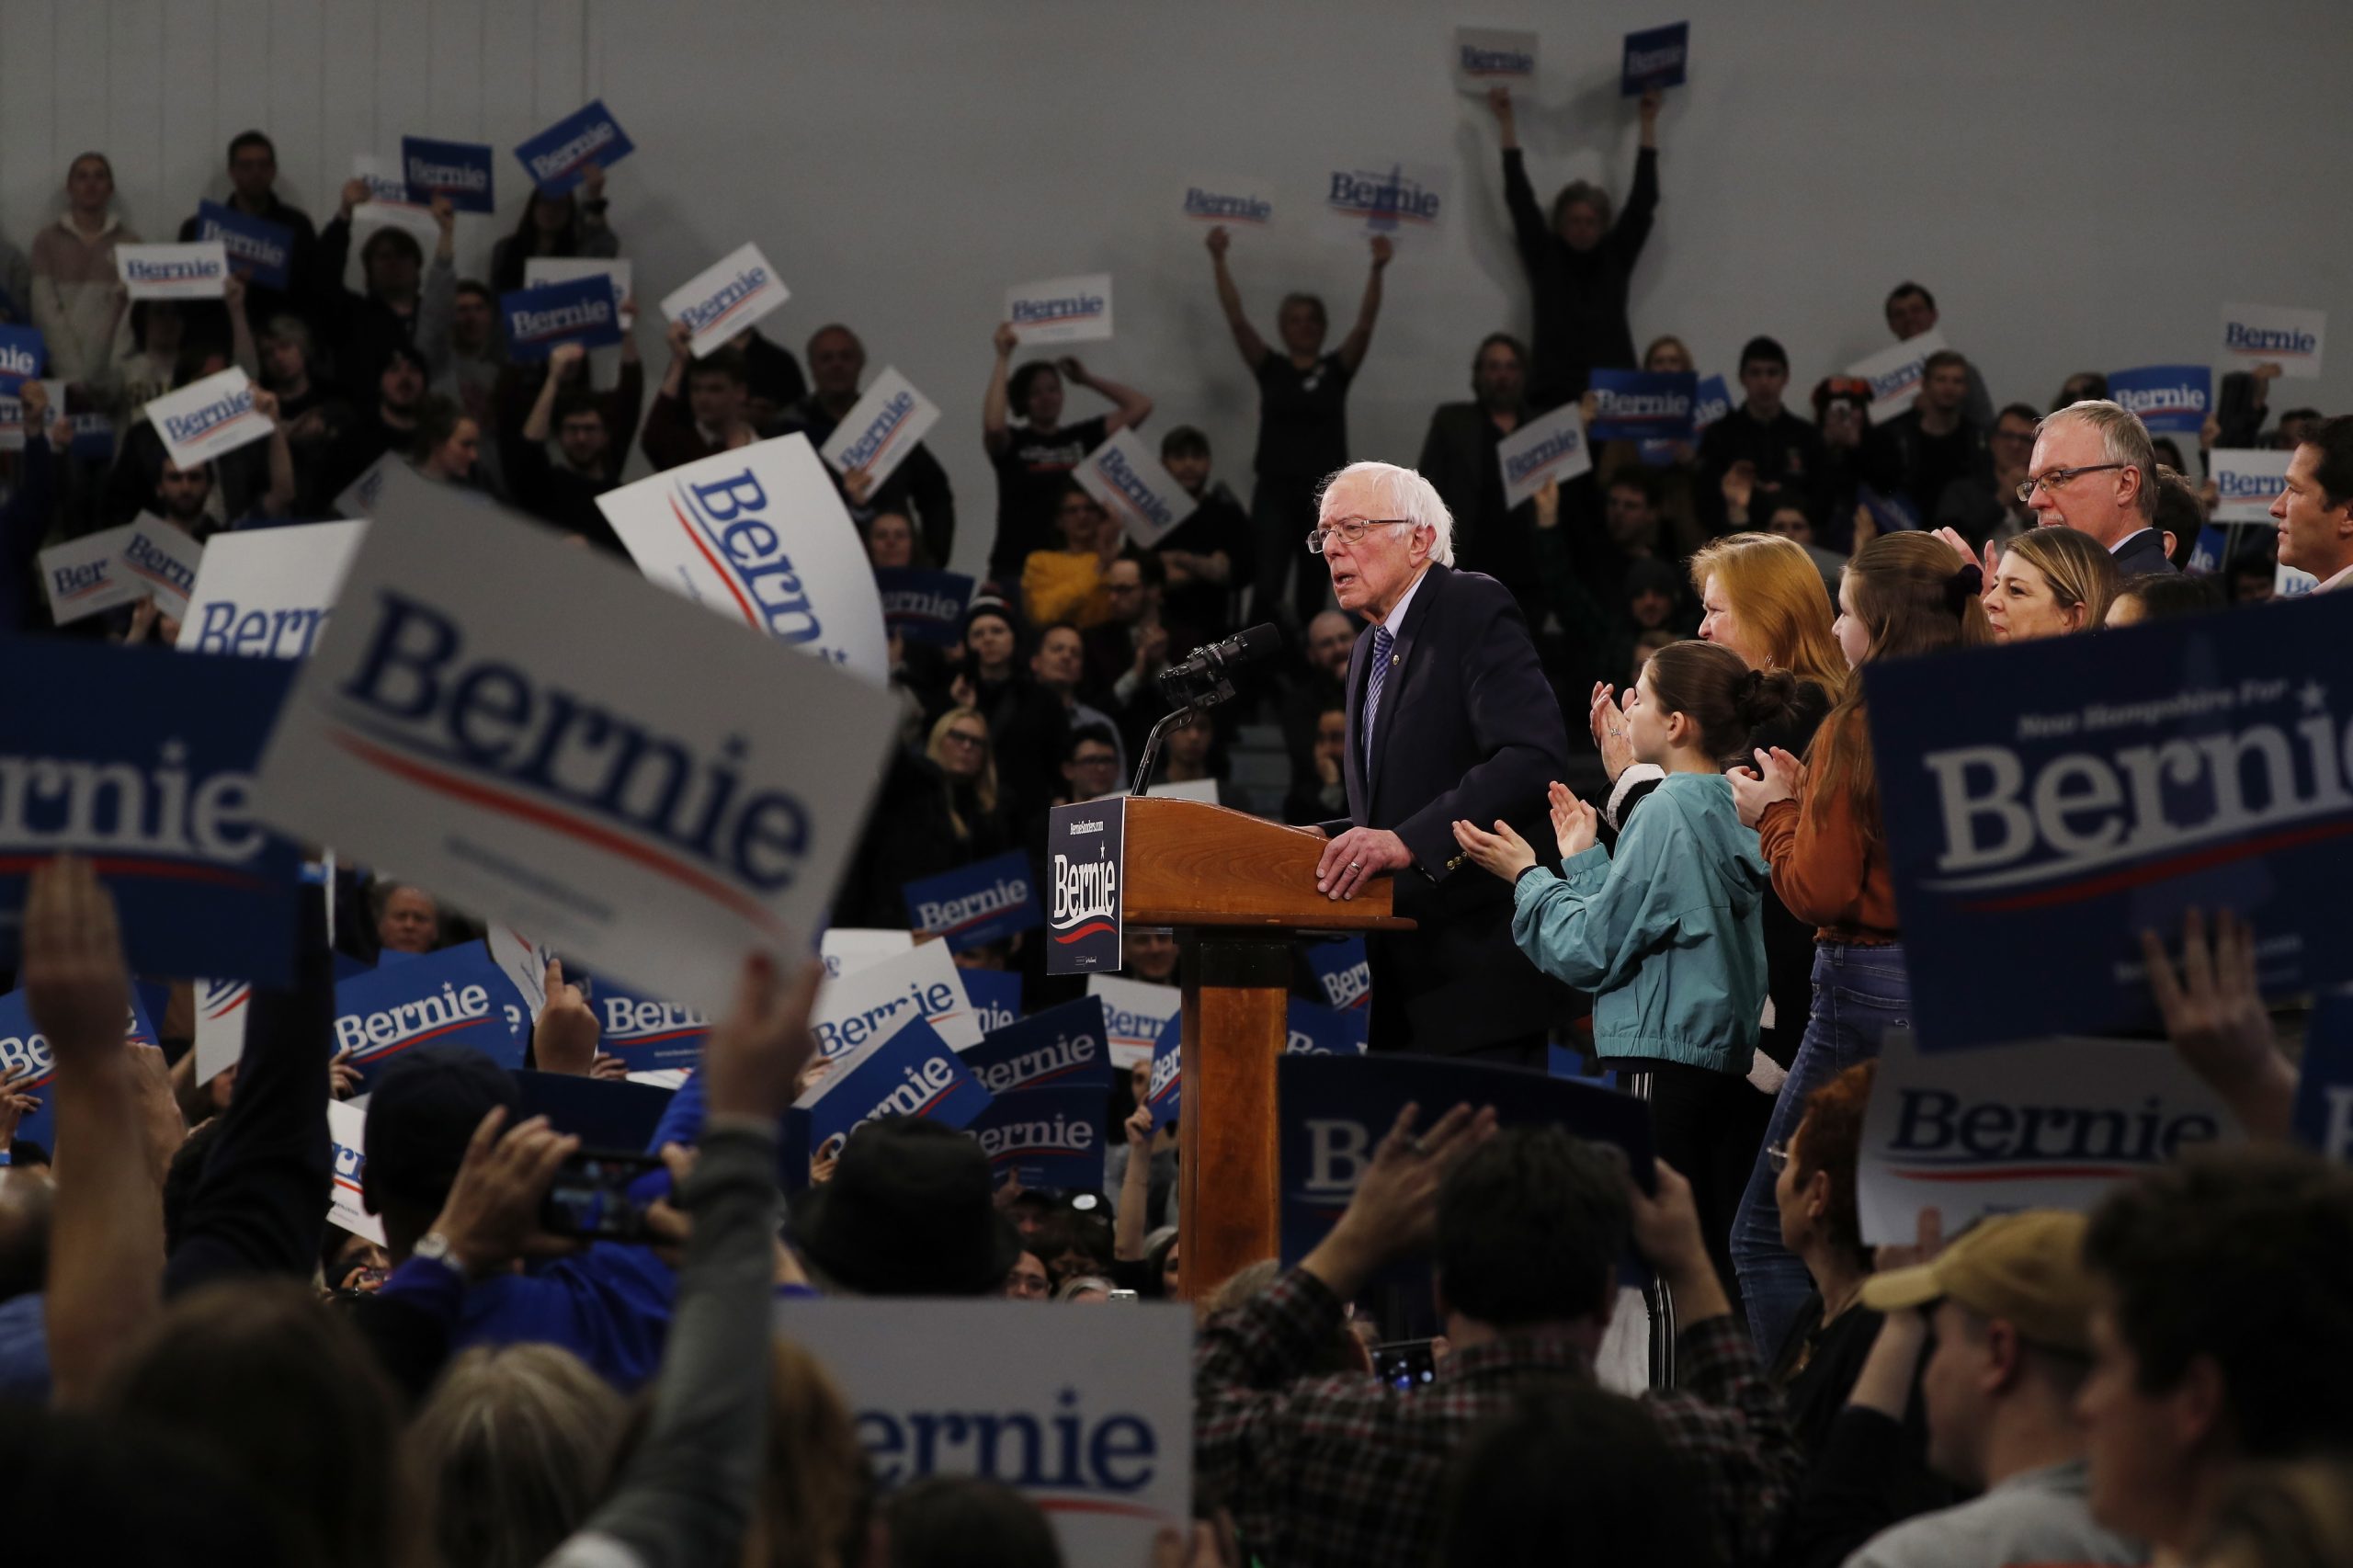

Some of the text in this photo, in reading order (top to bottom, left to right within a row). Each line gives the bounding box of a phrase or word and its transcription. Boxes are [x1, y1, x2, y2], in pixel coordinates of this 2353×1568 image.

[1330, 171, 1439, 218] Bernie
[127, 257, 221, 280] Bernie
[512, 299, 610, 336] Bernie
[680, 266, 767, 329] Bernie
[1012, 293, 1103, 322] Bernie
[2227, 323, 2315, 352] Bernie
[164, 391, 254, 443] Bernie
[1597, 387, 1690, 414] Bernie
[2116, 383, 2205, 412] Bernie
[1096, 448, 1173, 529] Bernie
[2219, 471, 2285, 497] Bern
[53, 559, 108, 594] Ber
[2082, 687, 2234, 732] Hampshire
[2239, 677, 2289, 706] For
[342, 586, 813, 896] Bernie
[1923, 682, 2353, 873] Berni
[917, 878, 1028, 931] Bernie
[1053, 841, 1116, 920] Bernie
[333, 982, 491, 1053] Bernie
[856, 1386, 1156, 1494] ernie
